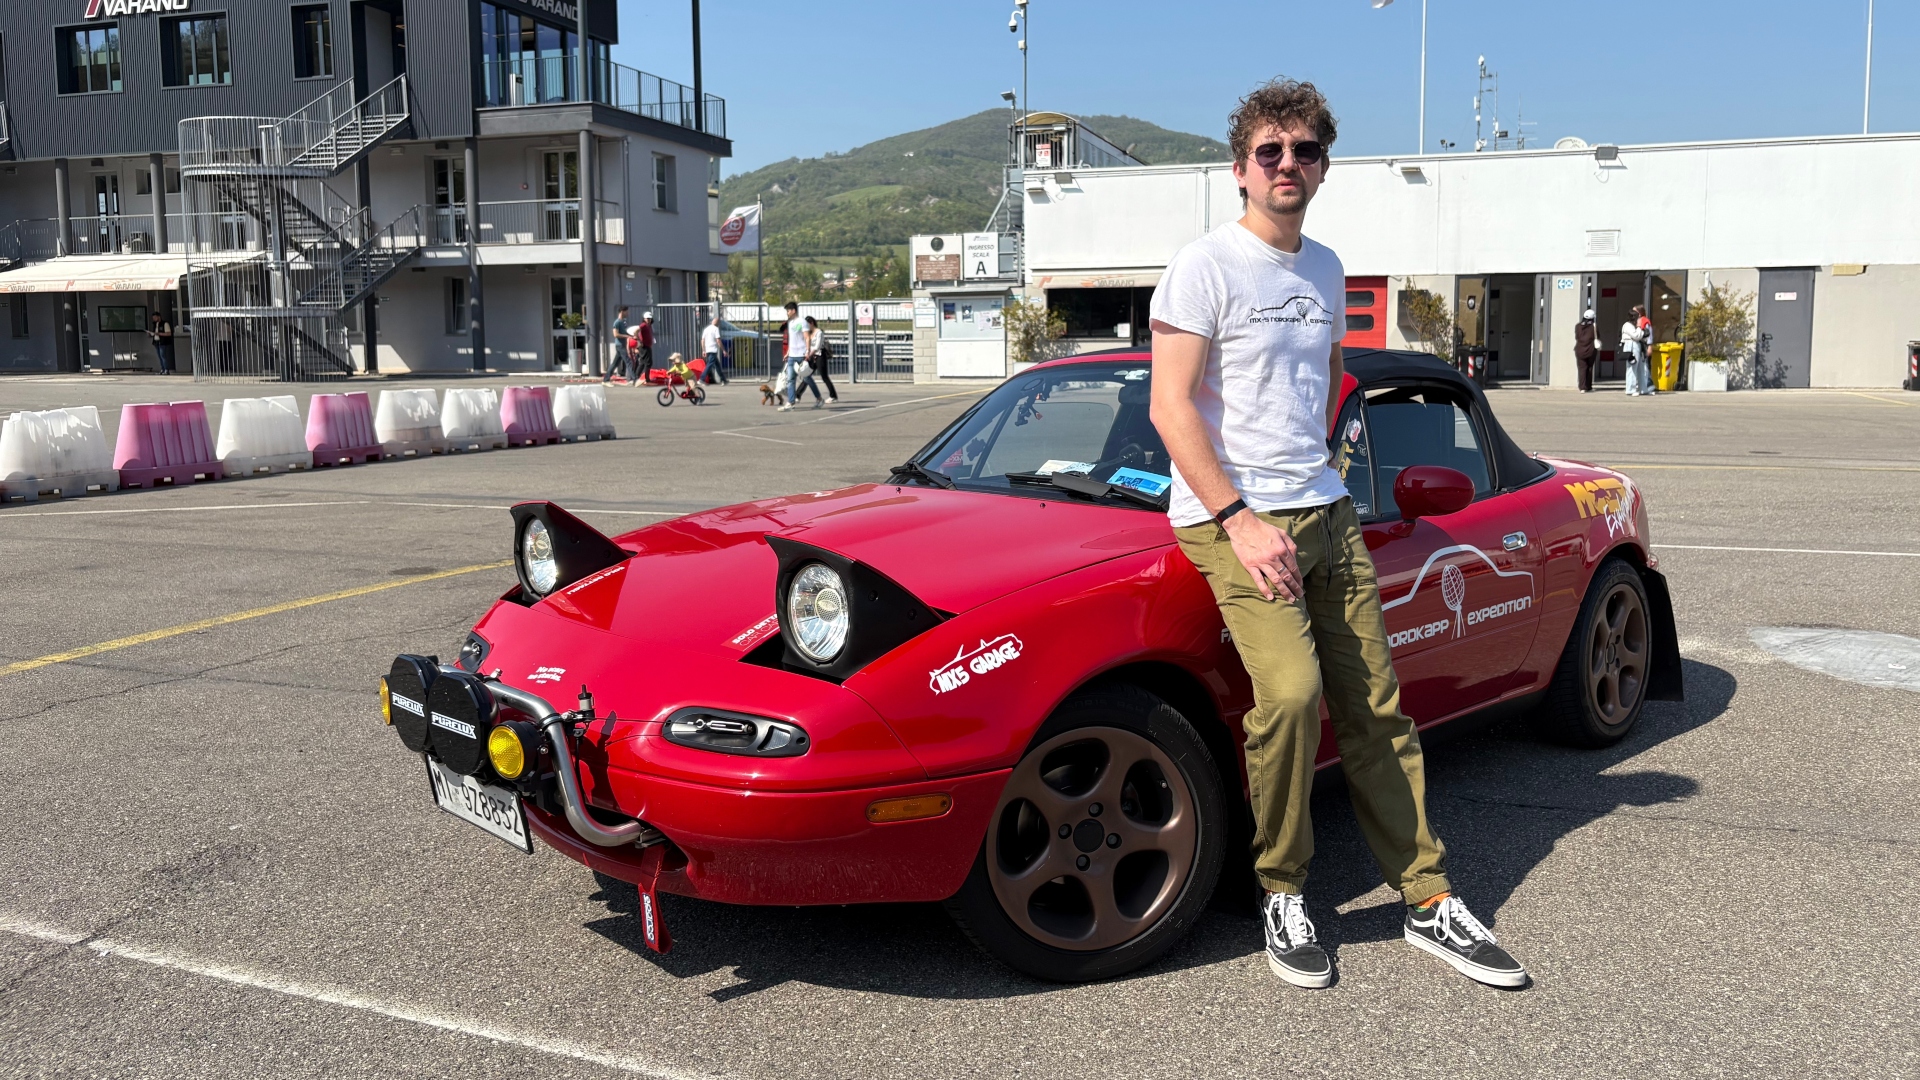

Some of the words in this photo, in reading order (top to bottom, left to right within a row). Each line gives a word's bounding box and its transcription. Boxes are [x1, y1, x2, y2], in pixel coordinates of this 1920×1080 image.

[975, 261, 987, 275] A
[732, 628, 756, 644] SOLO
[936, 665, 970, 693] MX5
[969, 640, 1021, 674] GARAGE
[392, 694, 425, 716] PURELUX
[431, 713, 477, 738] PURELUX
[433, 768, 453, 802] MI
[460, 782, 523, 837] 9Z8832
